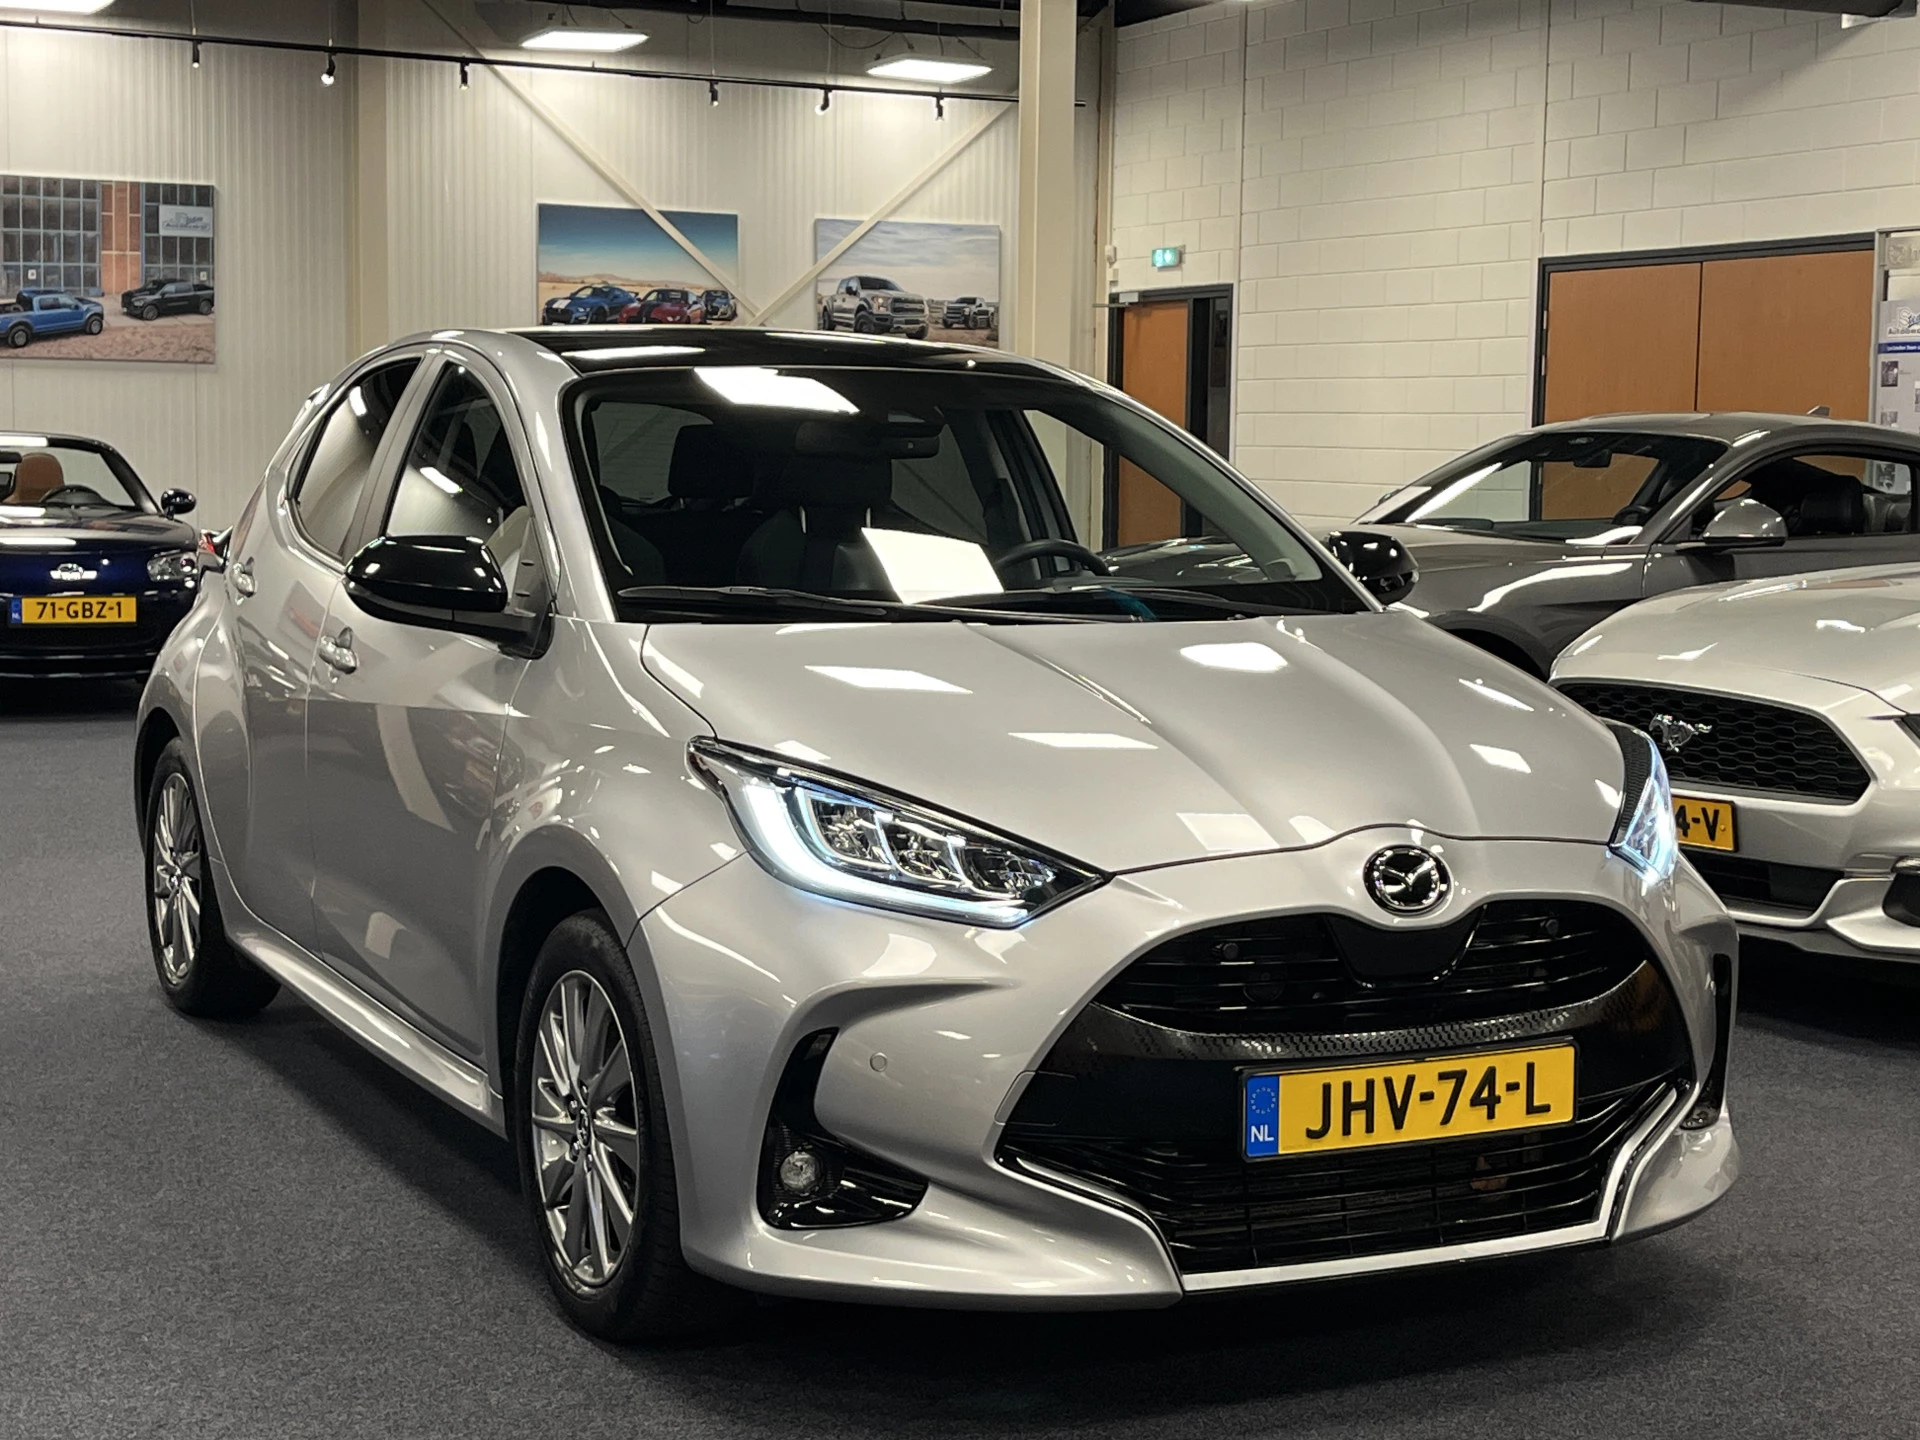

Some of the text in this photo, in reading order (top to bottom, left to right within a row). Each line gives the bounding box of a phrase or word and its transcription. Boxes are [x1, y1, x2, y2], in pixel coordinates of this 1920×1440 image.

[36, 601, 122, 619] 71-GBZ-1
[1306, 1061, 1551, 1140] JHV-74-L
[1250, 1124, 1275, 1143] NL
